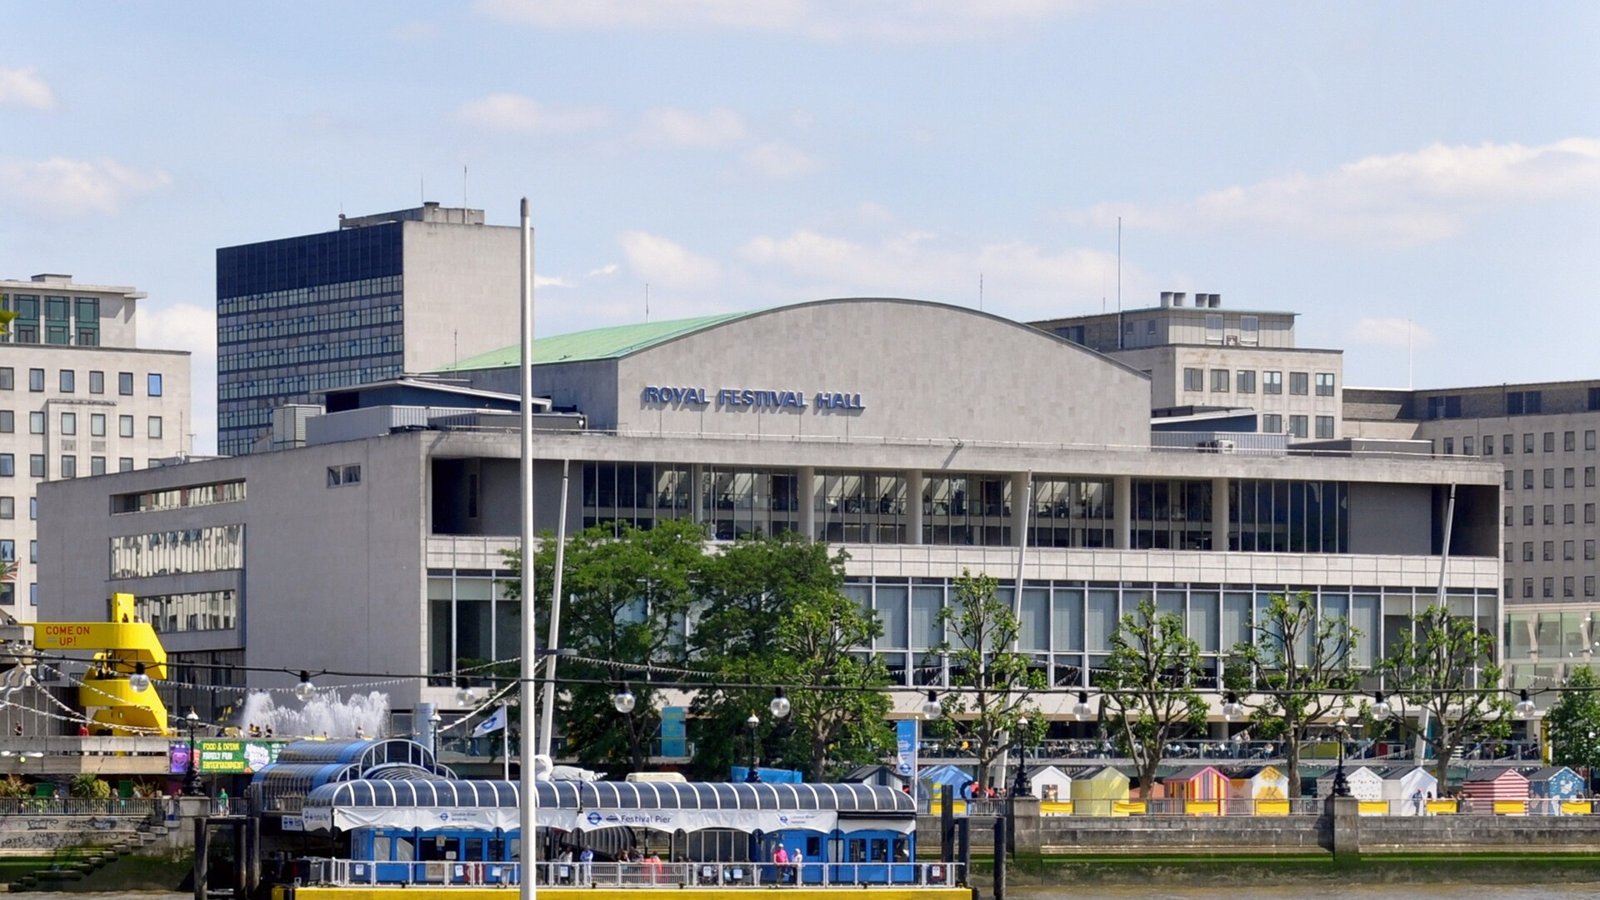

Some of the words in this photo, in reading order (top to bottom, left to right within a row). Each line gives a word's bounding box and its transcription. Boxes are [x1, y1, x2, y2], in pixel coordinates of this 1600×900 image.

[643, 386, 710, 404] ROYAL
[718, 388, 808, 408] FESTIVAL
[816, 391, 866, 409] HALL
[45, 625, 74, 635] COME
[76, 626, 90, 635] ON
[59, 636, 76, 646] UP!
[202, 742, 217, 750] FOOD
[621, 814, 653, 823] Festival
[655, 815, 671, 824] Pier
